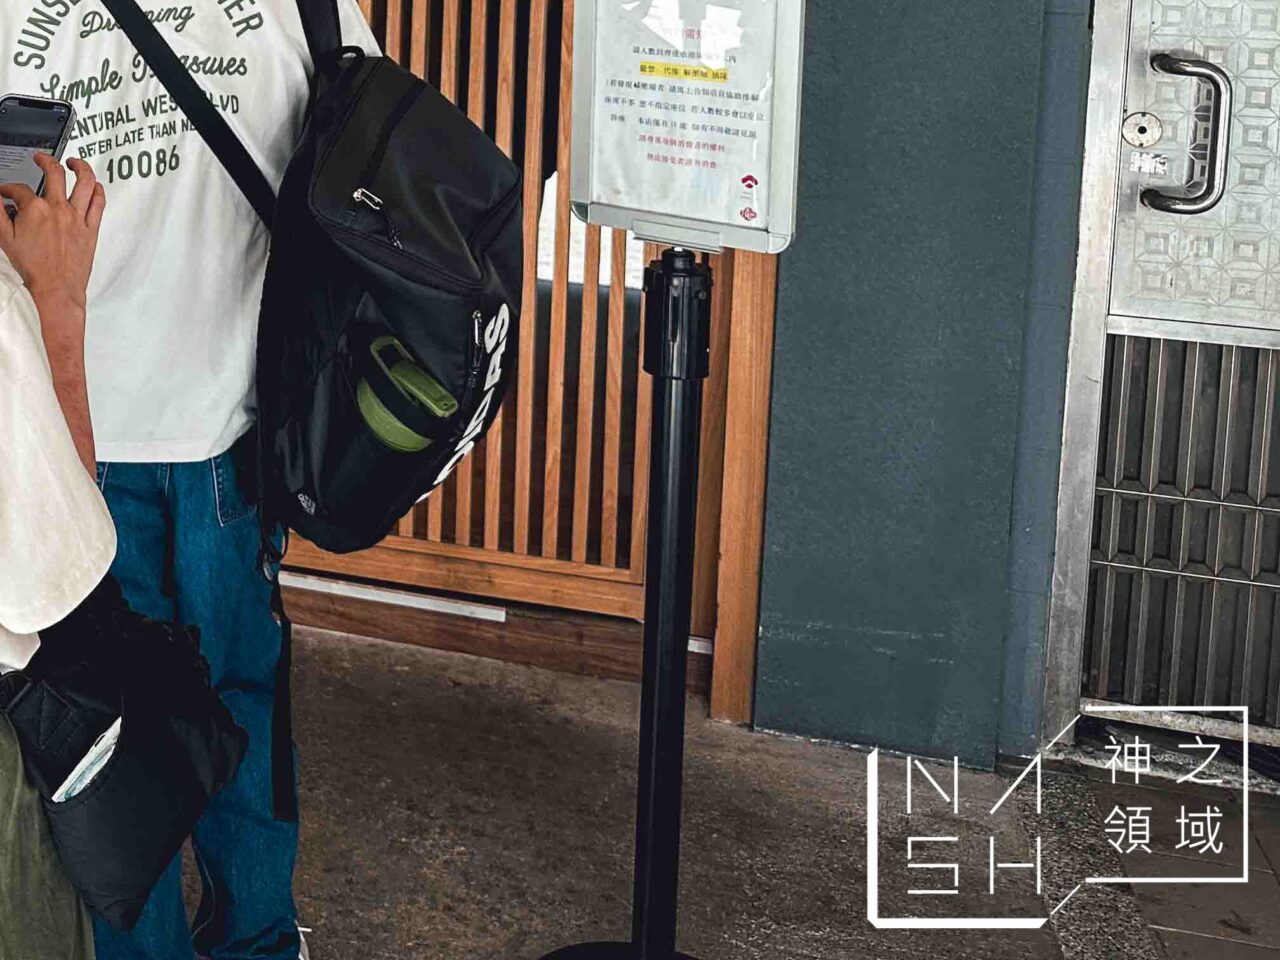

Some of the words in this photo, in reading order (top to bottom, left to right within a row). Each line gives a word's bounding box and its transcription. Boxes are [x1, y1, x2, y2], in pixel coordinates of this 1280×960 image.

[40, 57, 122, 109] Simple
[70, 104, 136, 141] ENTRAL
[141, 93, 179, 118] WES
[115, 127, 145, 148] LATE
[148, 120, 177, 140] THAN
[106, 144, 181, 184] 10086
